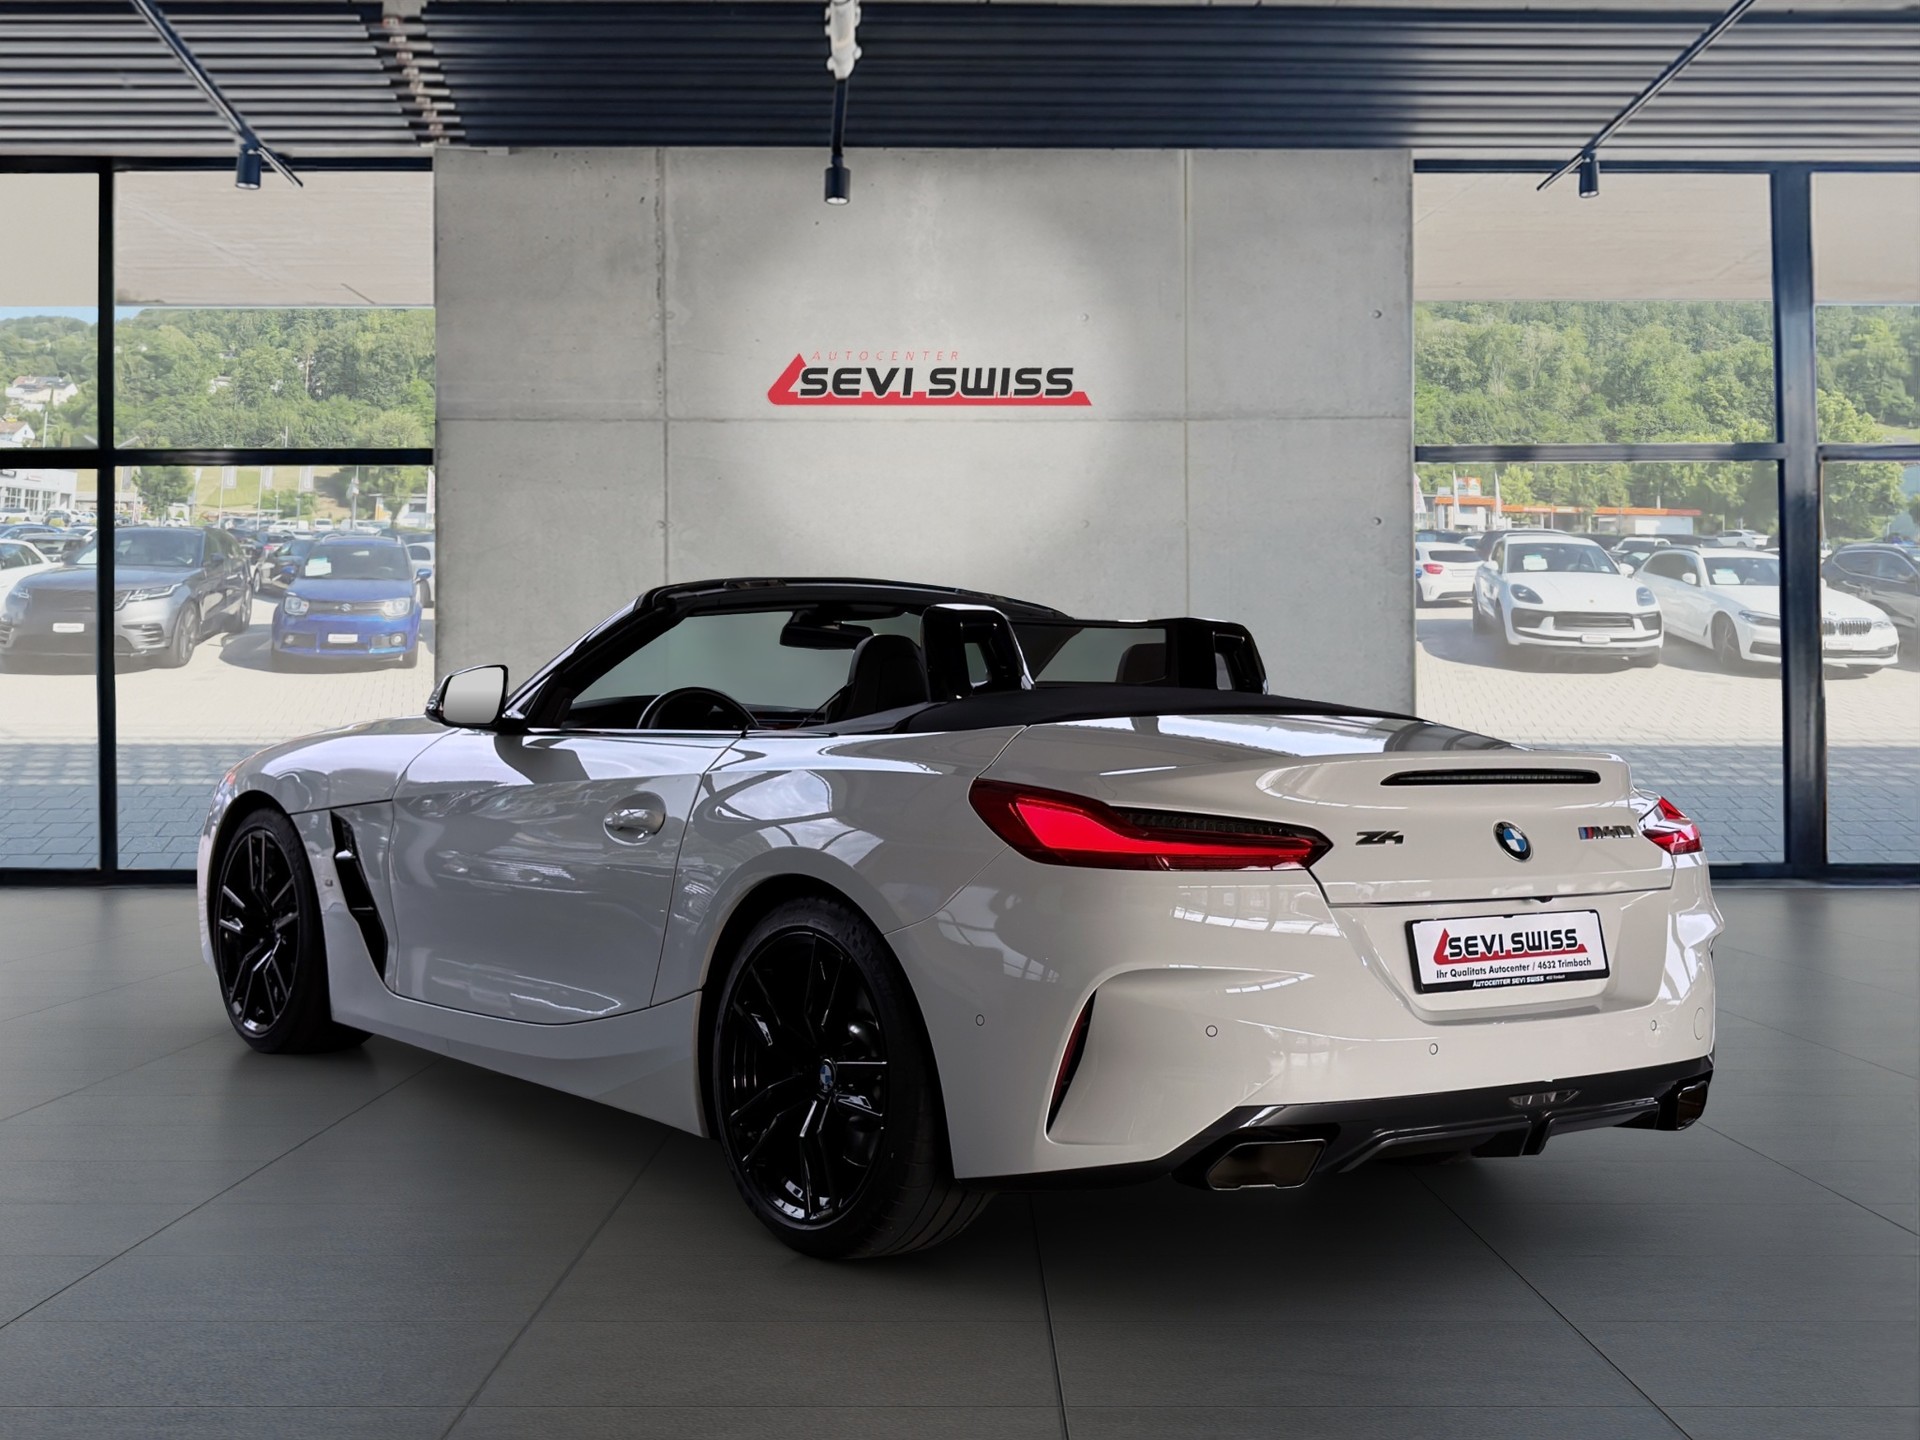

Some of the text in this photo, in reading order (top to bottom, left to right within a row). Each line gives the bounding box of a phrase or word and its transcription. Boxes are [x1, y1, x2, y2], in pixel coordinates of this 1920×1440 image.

[811, 351, 960, 361] AUTOCENTER
[799, 367, 1074, 397] SEVI SWISS
[1356, 830, 1404, 846] Z4
[1448, 928, 1578, 958] SEVI SWISS
[1436, 969, 1448, 978] Ihr
[1488, 963, 1530, 974] Autocenter
[1537, 960, 1556, 970] 4632
[1557, 957, 1592, 969] Trimbach
